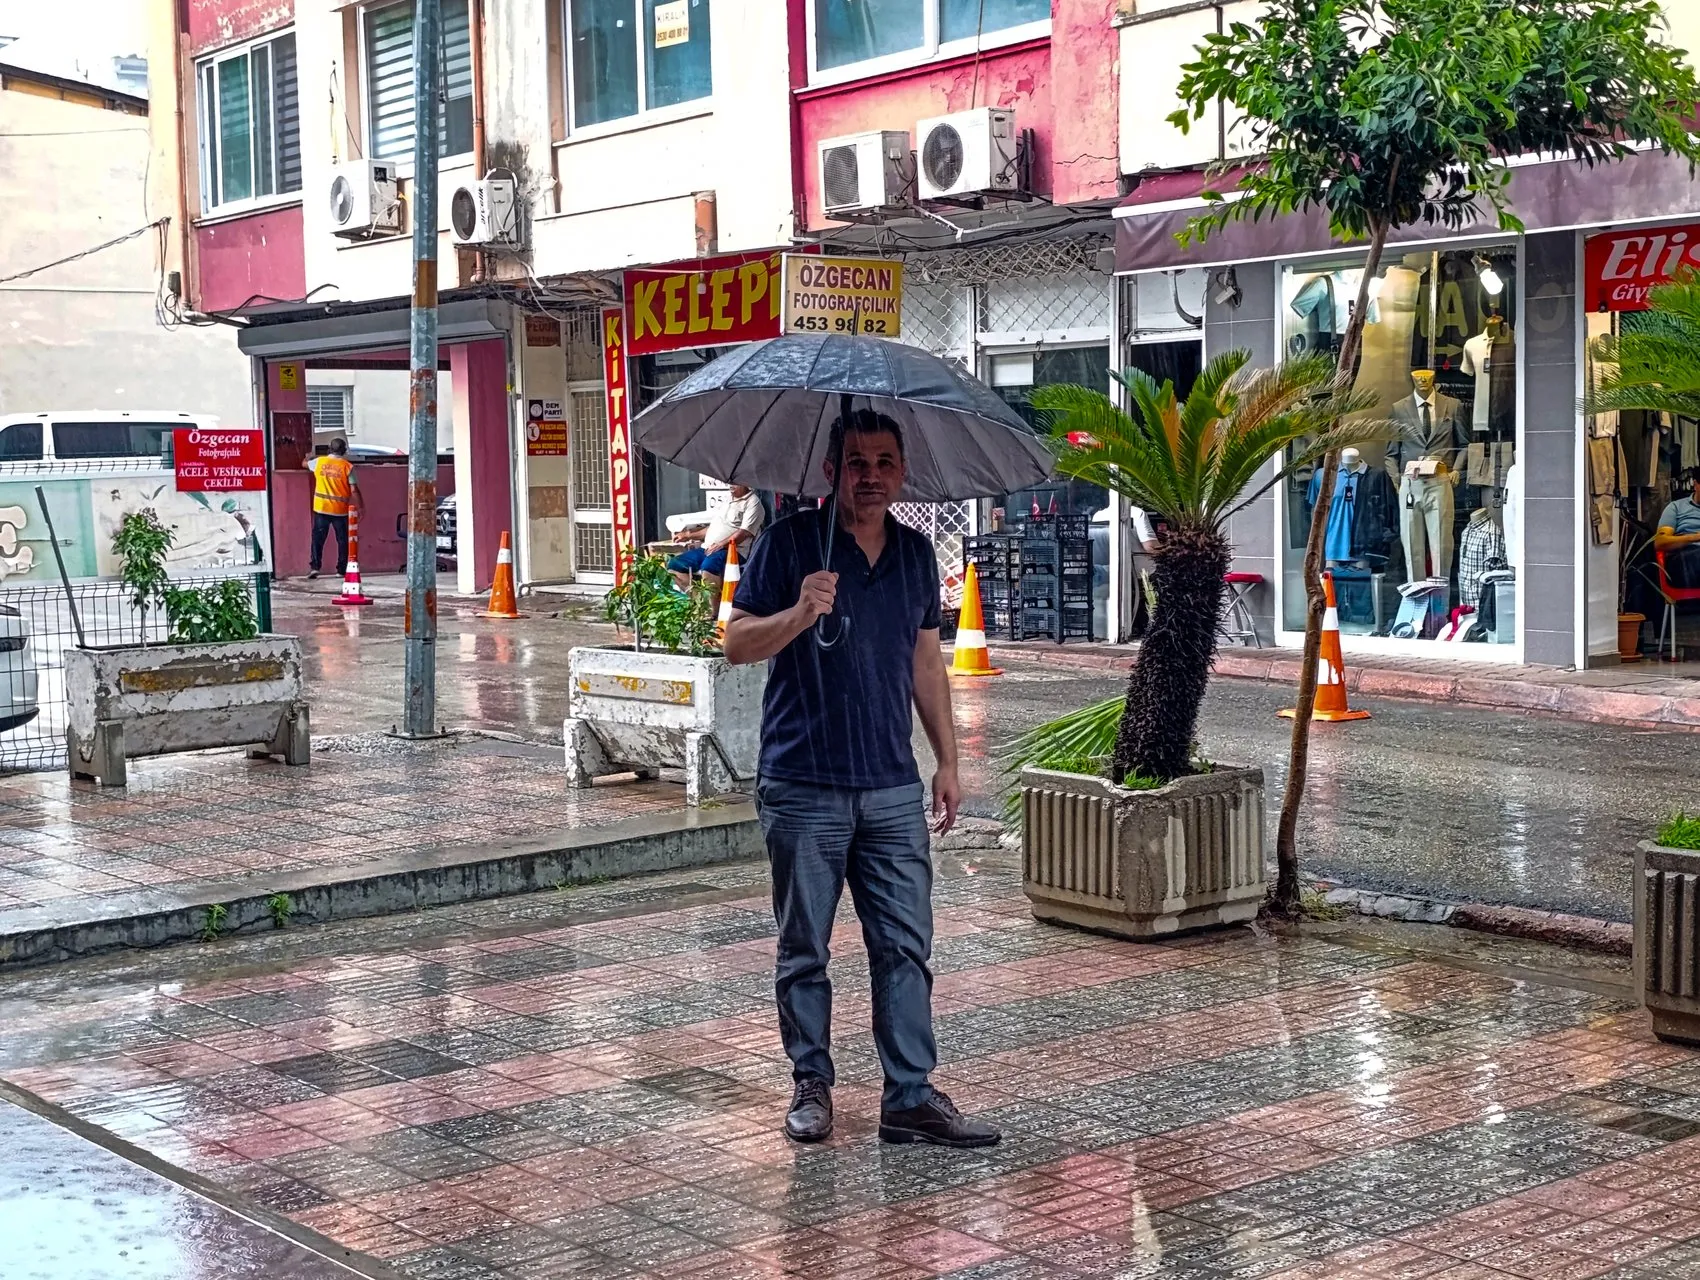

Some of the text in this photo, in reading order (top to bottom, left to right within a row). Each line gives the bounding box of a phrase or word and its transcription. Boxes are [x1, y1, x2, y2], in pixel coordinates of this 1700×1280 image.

[800, 259, 892, 290] ÖZGECAN
[1612, 282, 1656, 303] Giy
[793, 292, 898, 317] FOTOGRAFÇILIK
[794, 315, 829, 331] 453
[864, 319, 887, 334] 82
[544, 408, 563, 416] PARTİ
[188, 428, 250, 447] Özgecan
[198, 447, 241, 460] Fotoğrafçılık
[178, 465, 263, 477] ACELE VESİKALIK
[203, 477, 243, 490] ÇEKİLİR
